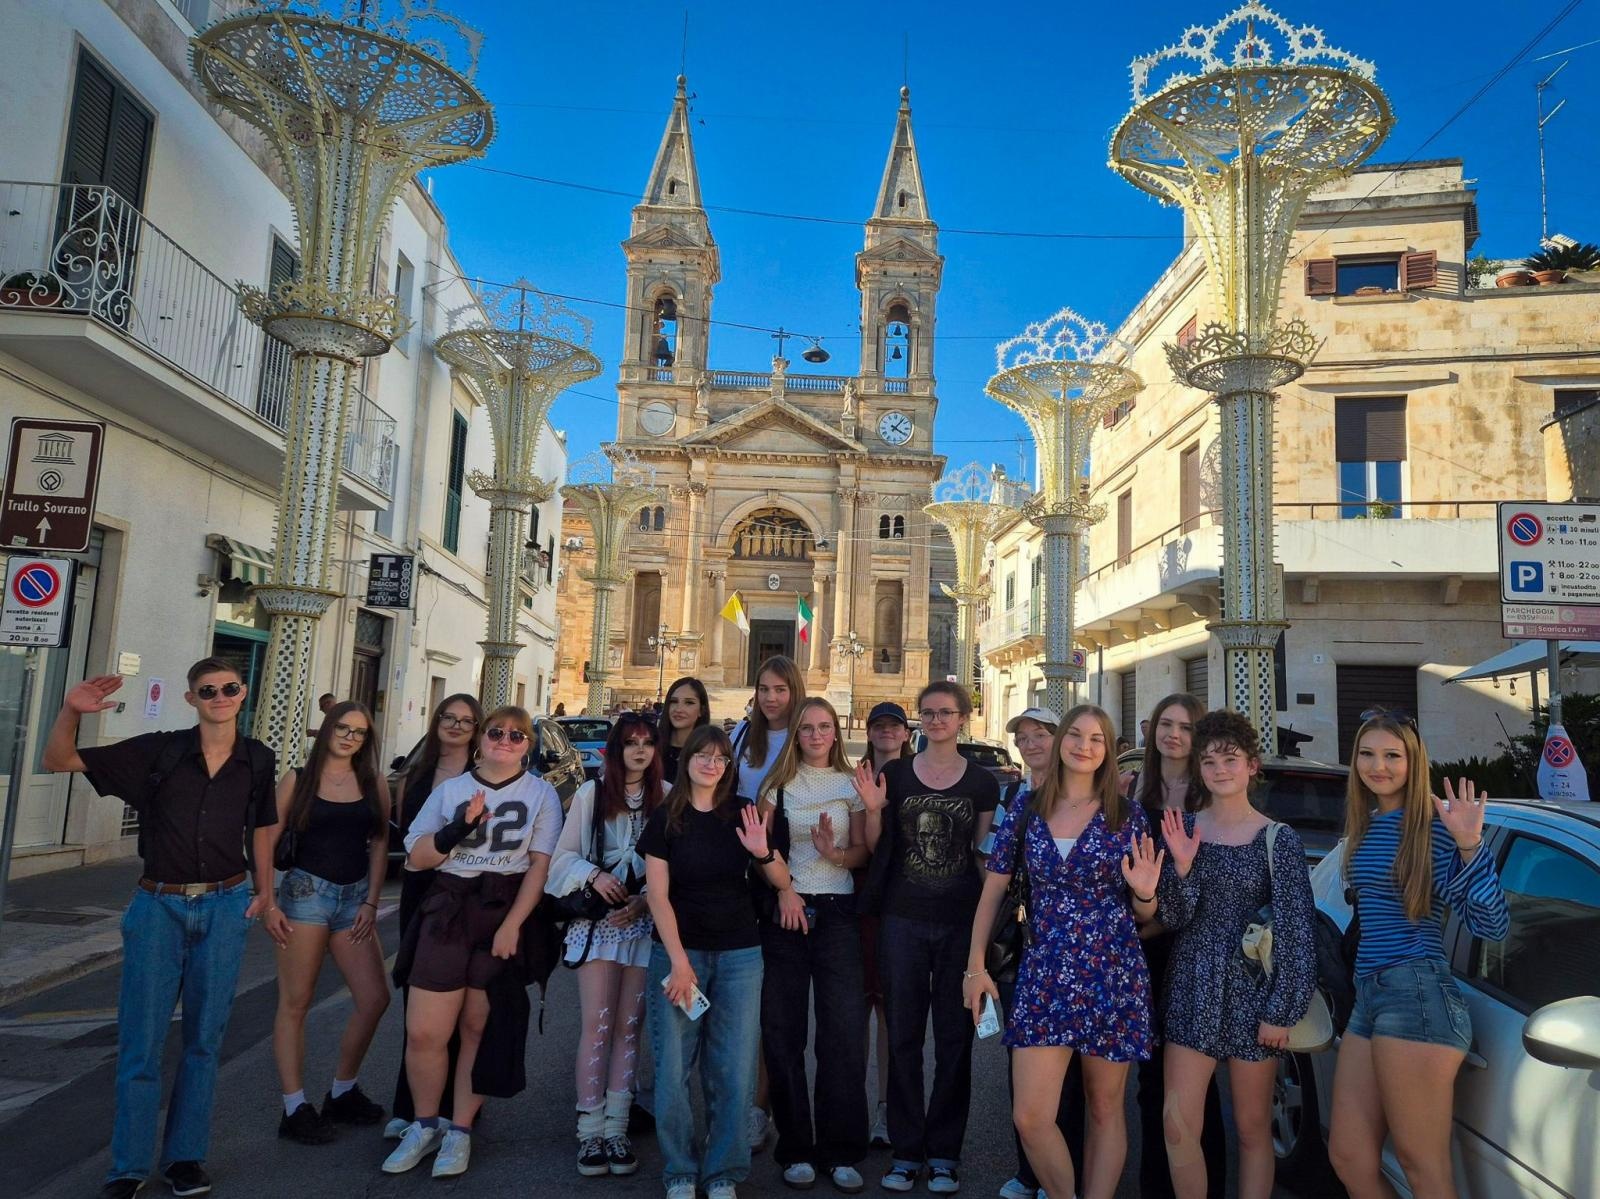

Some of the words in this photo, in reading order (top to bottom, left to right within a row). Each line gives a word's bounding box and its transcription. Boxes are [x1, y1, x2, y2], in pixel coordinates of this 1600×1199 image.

[8, 500, 40, 512] Trullo
[43, 502, 87, 515] Sovrano
[378, 557, 396, 578] T
[1518, 566, 1537, 588] P
[1506, 607, 1555, 615] PARCHEGGIA
[453, 852, 511, 866] BROOKLYN
